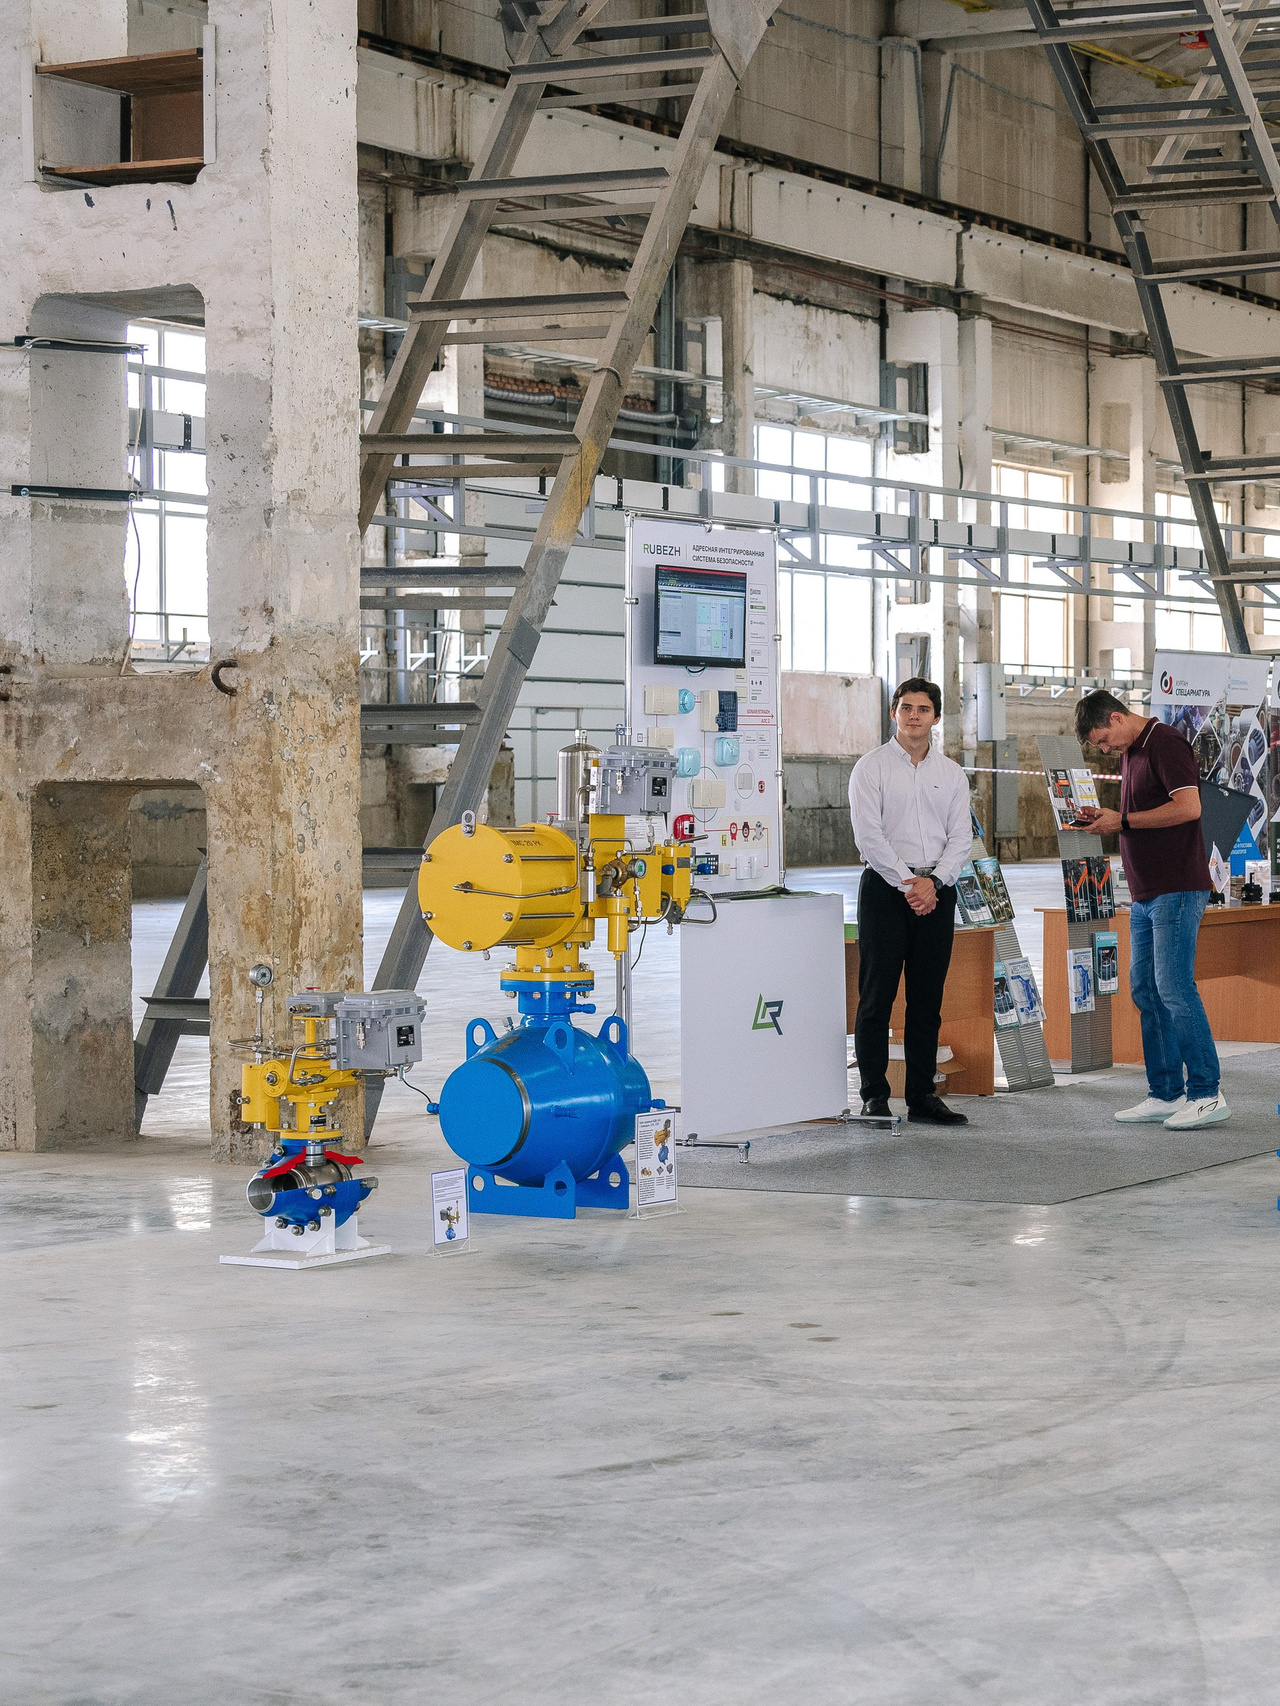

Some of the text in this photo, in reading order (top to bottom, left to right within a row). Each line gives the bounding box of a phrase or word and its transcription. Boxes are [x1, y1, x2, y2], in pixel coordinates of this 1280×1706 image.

[643, 544, 681, 556] RUBEZH
[692, 545, 765, 557] АДРЕСНАЯ ИНТЕГРИРОВАННАЯ
[692, 555, 754, 566] СИСТЕМА БЕЗОПАСНОСТИ
[1175, 688, 1211, 697] СПЕЦАРМАТУРА
